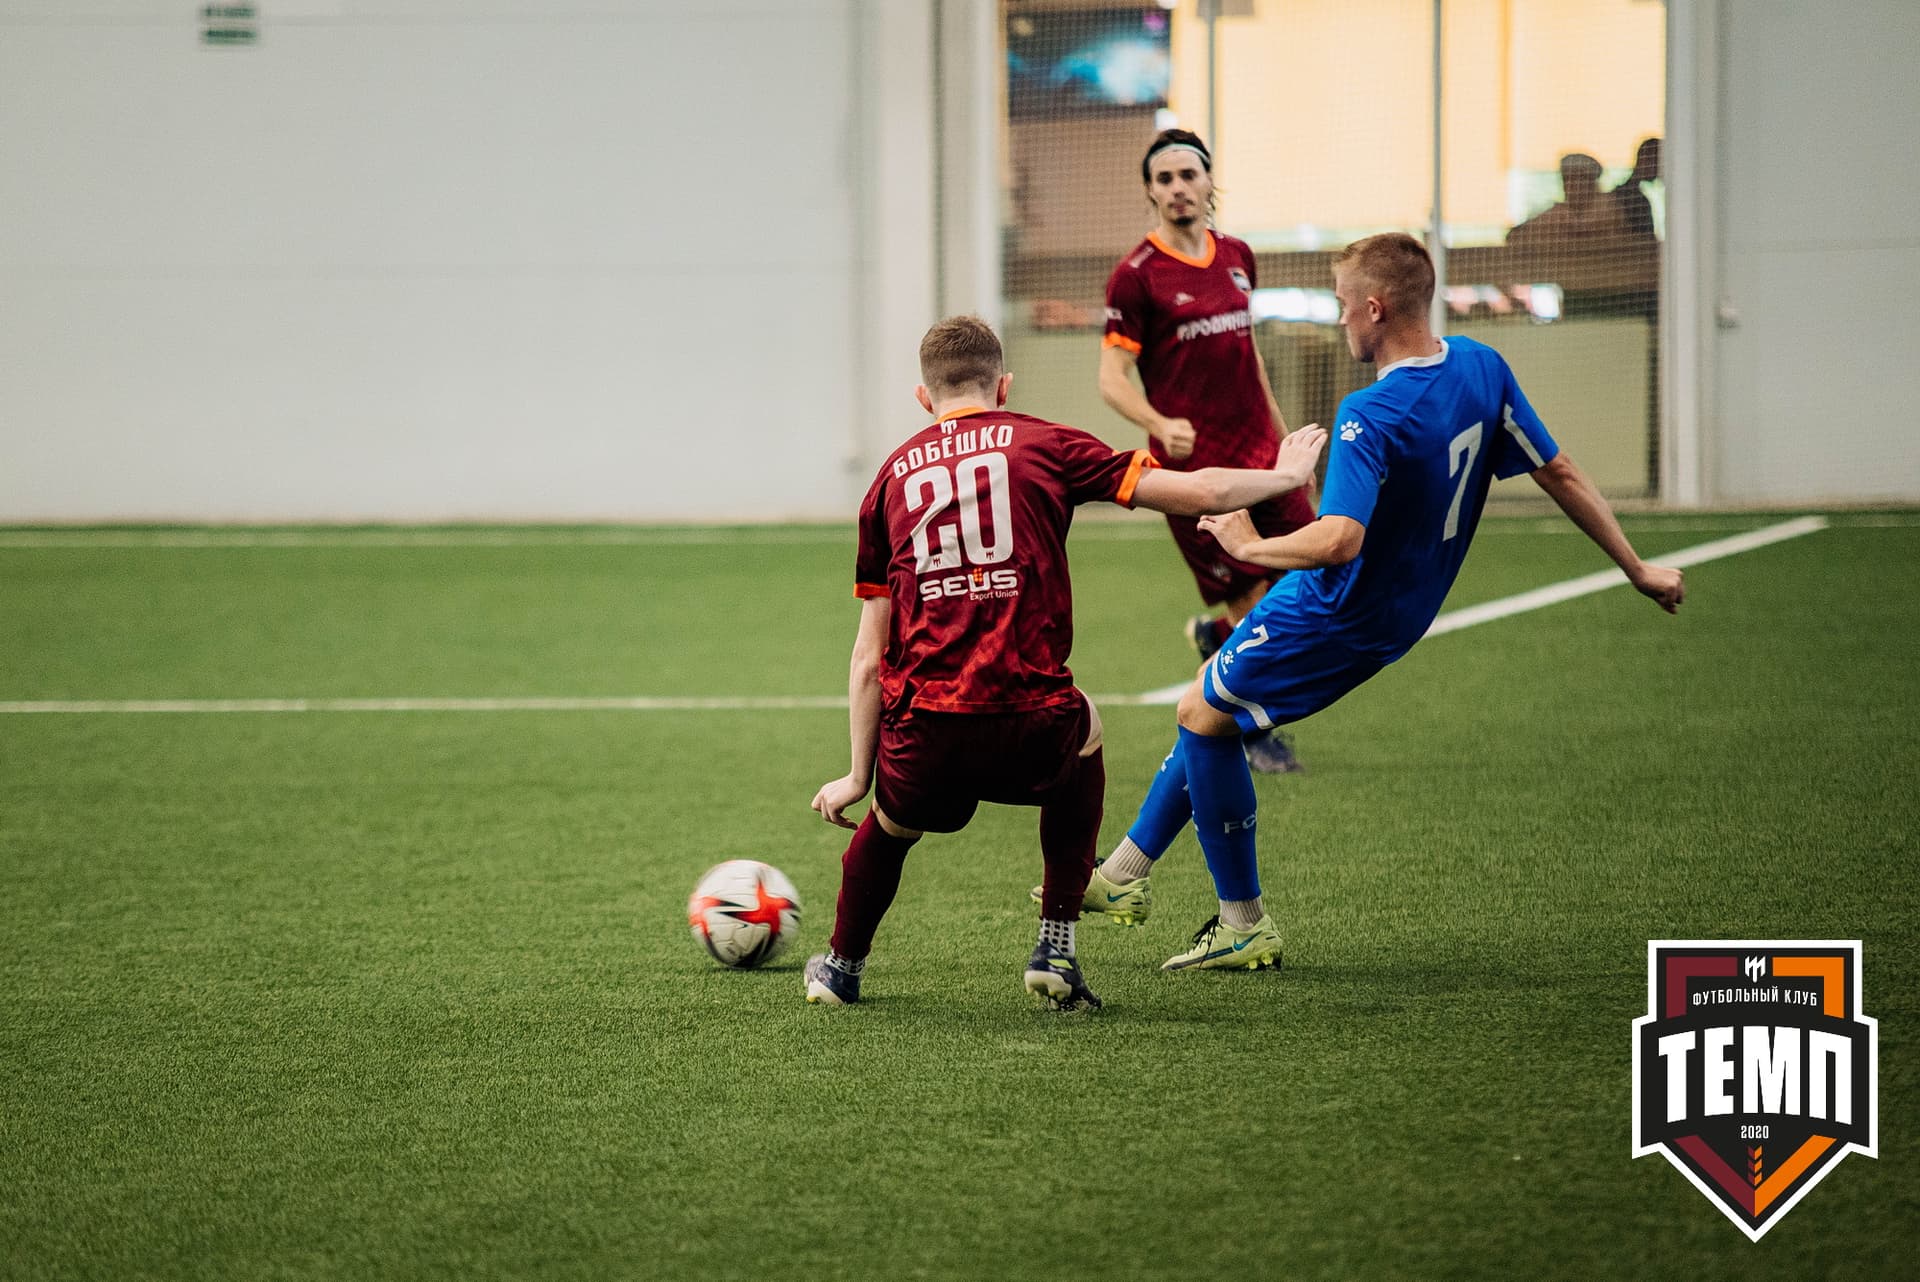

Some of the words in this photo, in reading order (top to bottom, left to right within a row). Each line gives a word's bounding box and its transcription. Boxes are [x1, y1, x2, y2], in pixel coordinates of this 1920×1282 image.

[893, 425, 1013, 479] БОБЕШКО
[1443, 421, 1483, 542] 7
[904, 452, 1013, 575] 20
[920, 569, 1017, 601] SEUS
[970, 592, 993, 601] Export
[995, 590, 1019, 598] Union
[1236, 624, 1269, 654] 7
